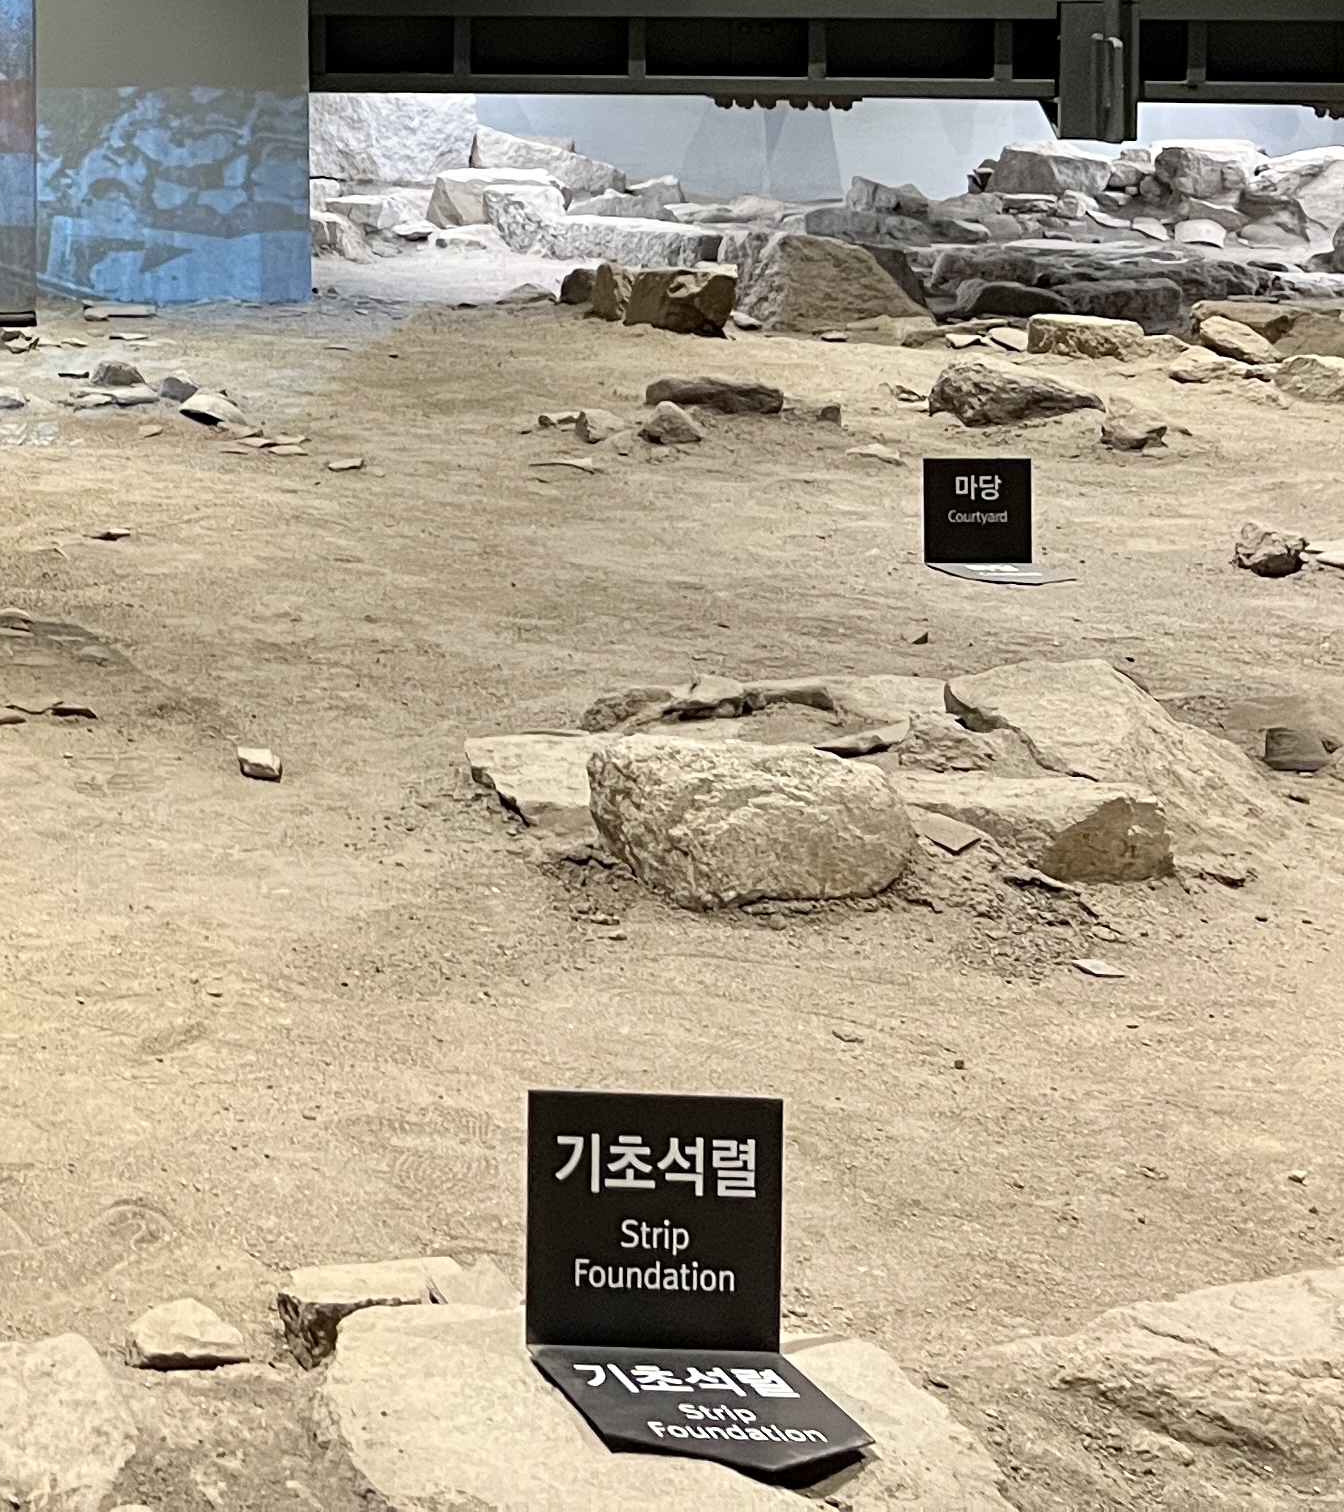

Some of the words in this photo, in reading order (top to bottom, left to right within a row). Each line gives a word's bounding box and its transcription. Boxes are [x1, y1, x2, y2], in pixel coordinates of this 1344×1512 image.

[955, 474, 1003, 500] 마당
[947, 509, 1008, 525] Courtyard
[554, 1132, 757, 1198] 기초석렬
[620, 1218, 690, 1256] Strip
[573, 1258, 736, 1293] Foundation
[573, 1363, 801, 1399] 기초석렬
[677, 1402, 757, 1424] Strip
[646, 1419, 829, 1444] Foundation
